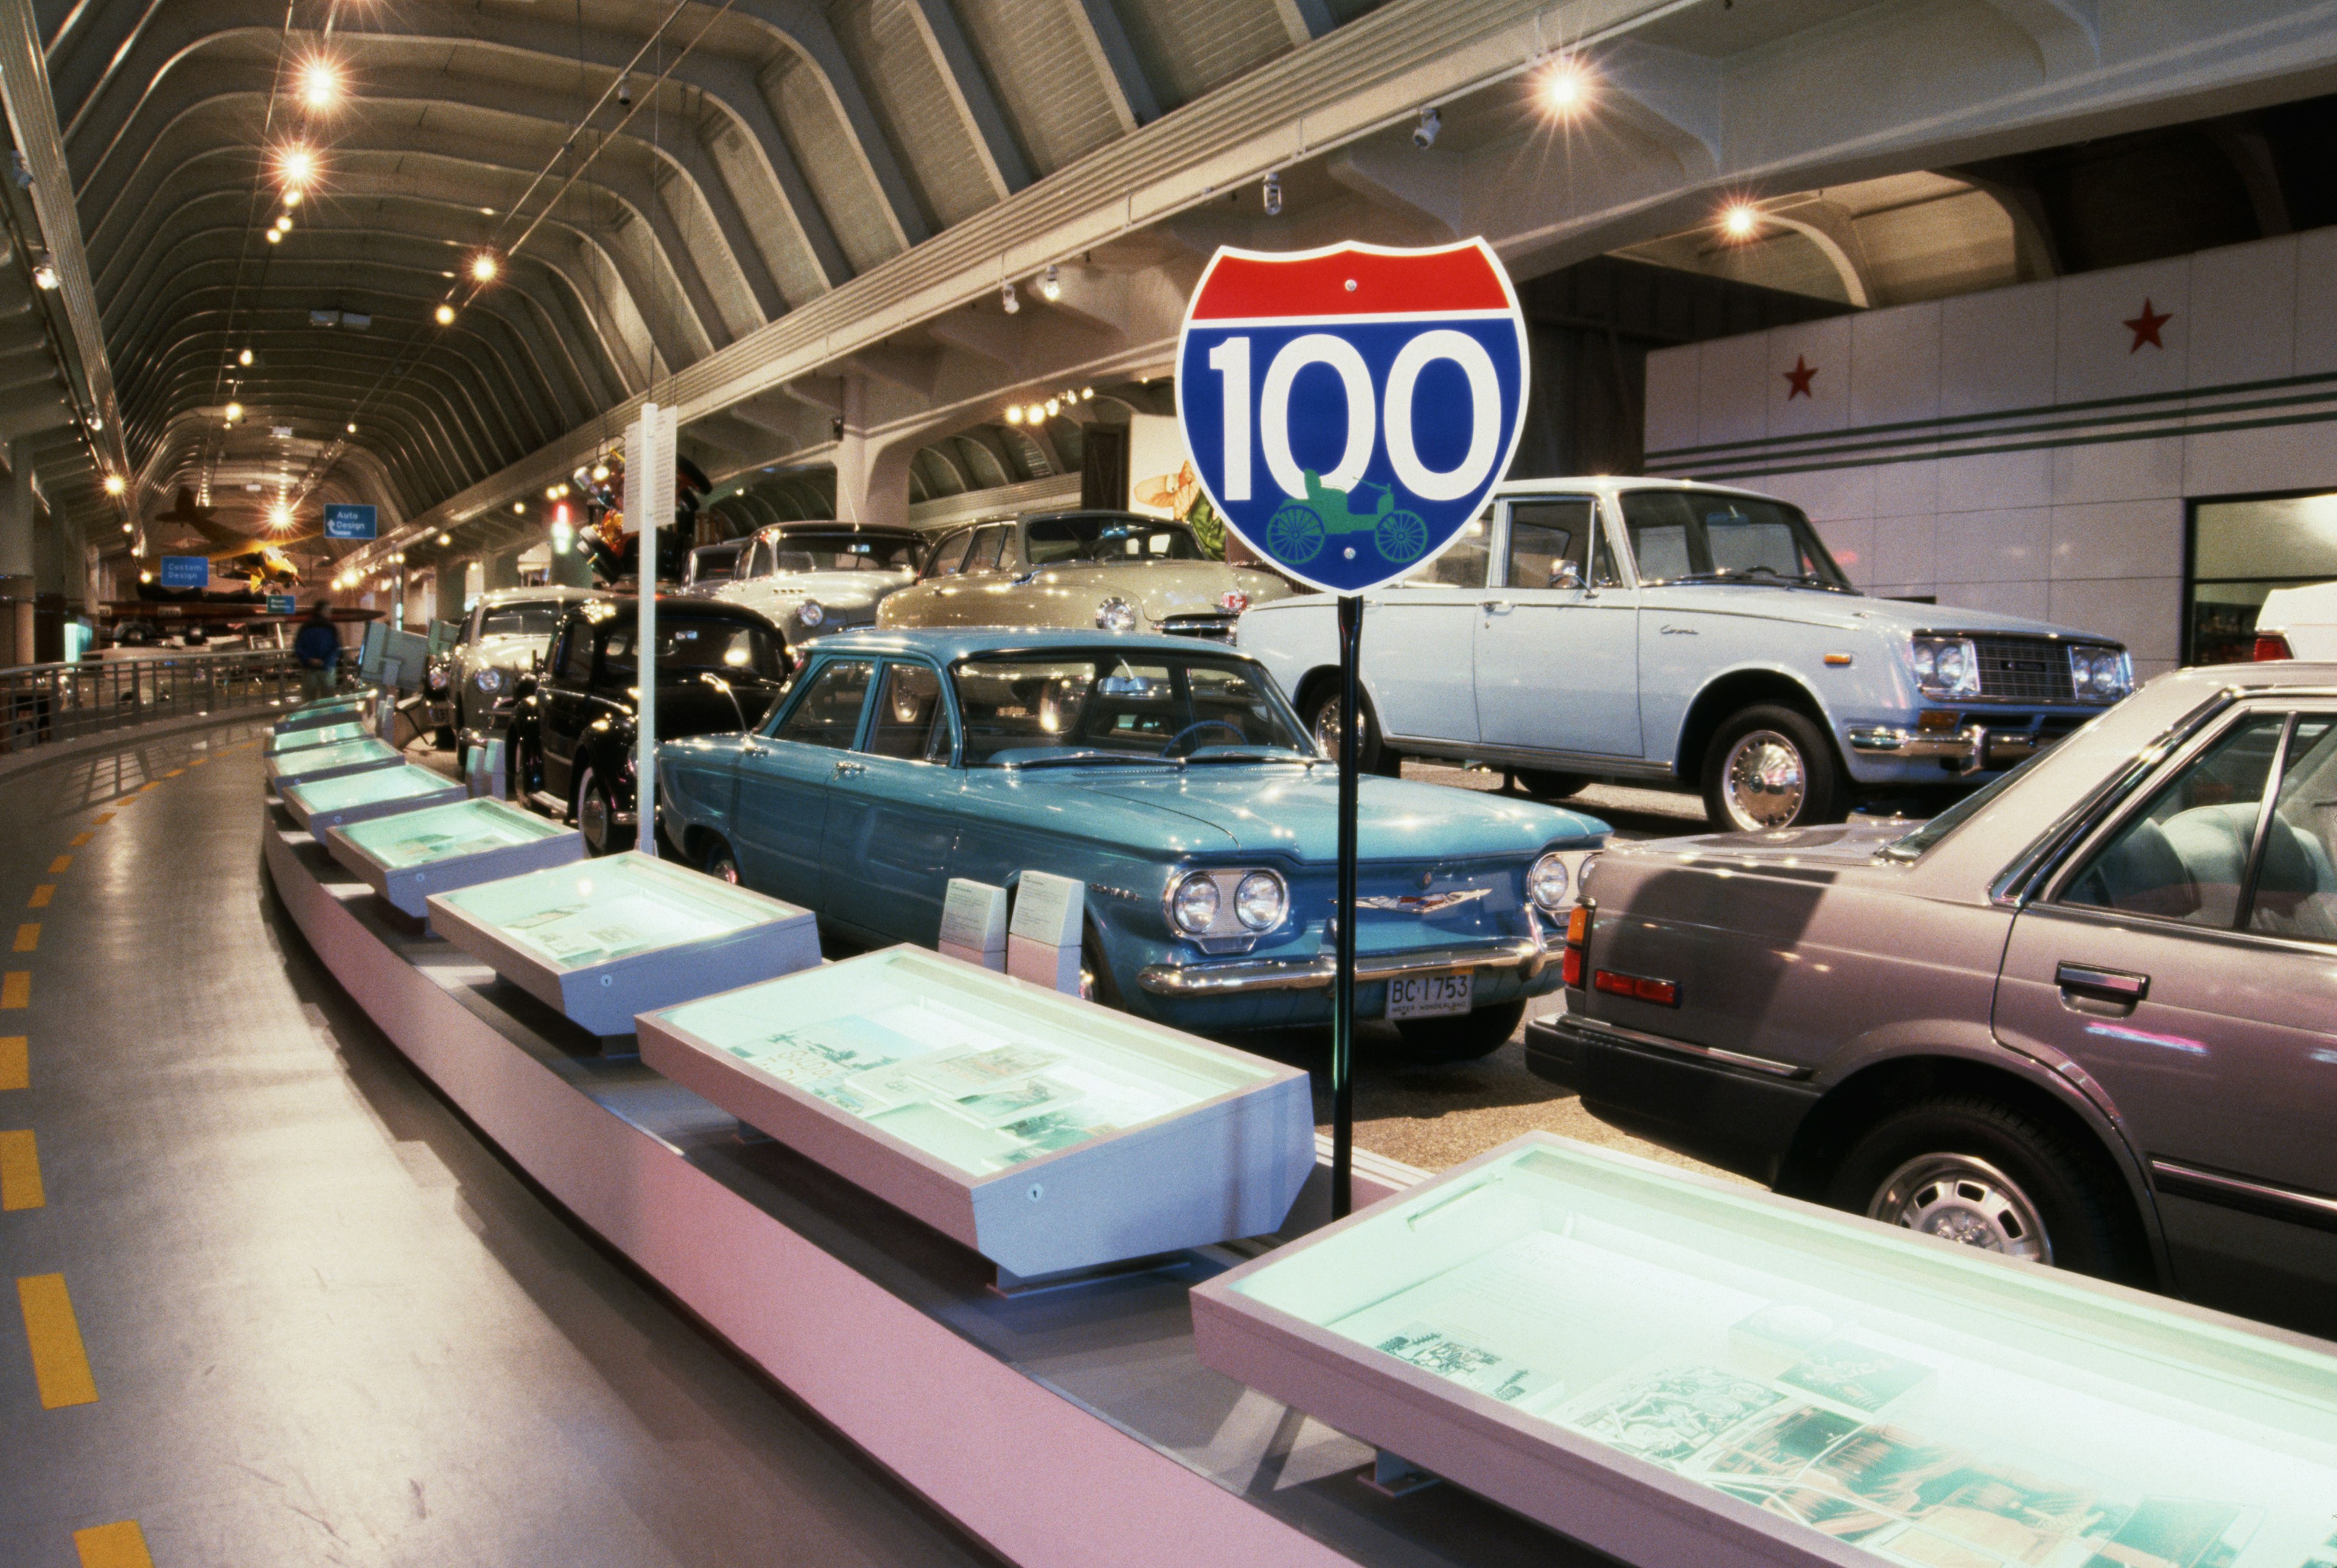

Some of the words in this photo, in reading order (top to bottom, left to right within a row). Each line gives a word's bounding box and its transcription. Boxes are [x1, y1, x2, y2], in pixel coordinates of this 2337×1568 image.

[1209, 329, 1501, 501] 100
[336, 521, 365, 531] Design
[168, 572, 198, 580] Design
